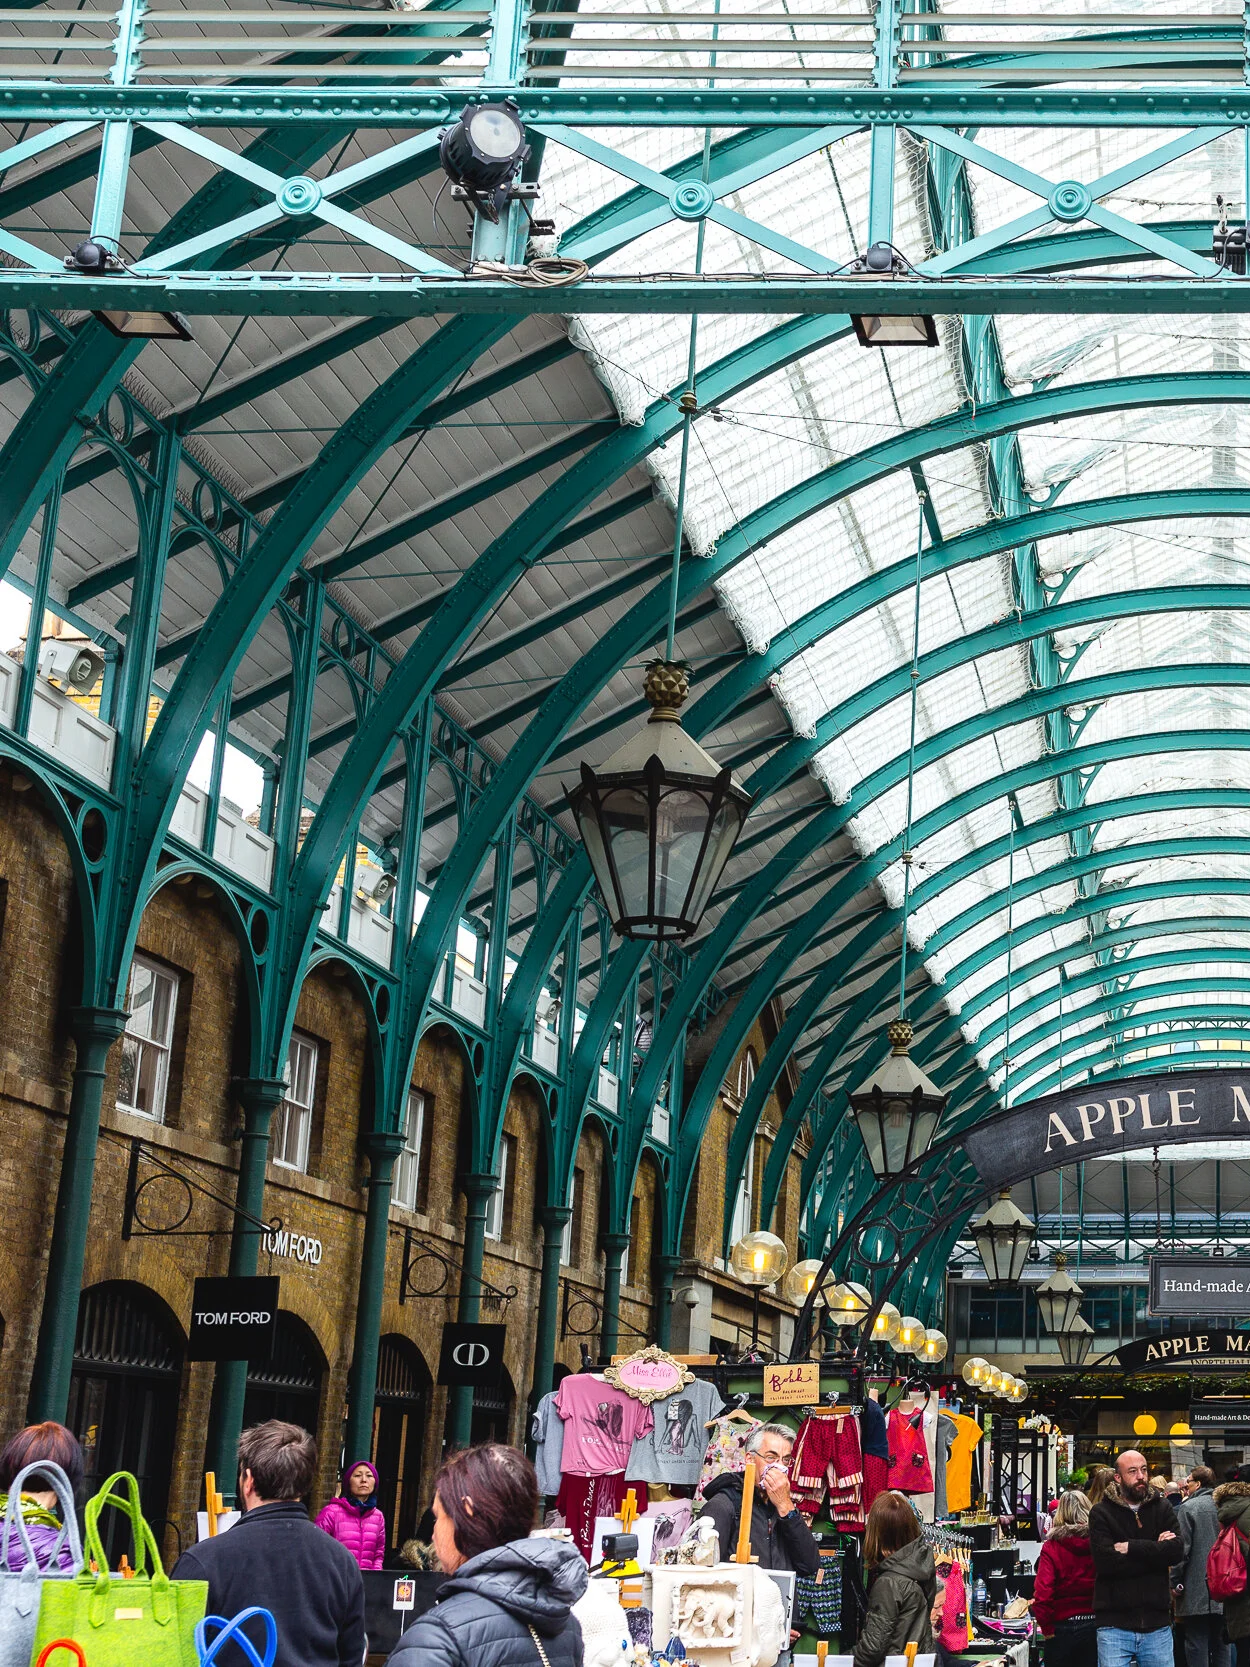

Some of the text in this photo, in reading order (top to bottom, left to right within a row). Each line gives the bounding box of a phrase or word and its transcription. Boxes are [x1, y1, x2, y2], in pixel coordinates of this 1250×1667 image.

[1043, 1088, 1200, 1153] APPLE
[289, 1233, 322, 1264] FORD
[1164, 1280, 1244, 1293] Hand-made
[195, 1312, 271, 1325] TOM FORD
[1145, 1335, 1211, 1362] APPLE
